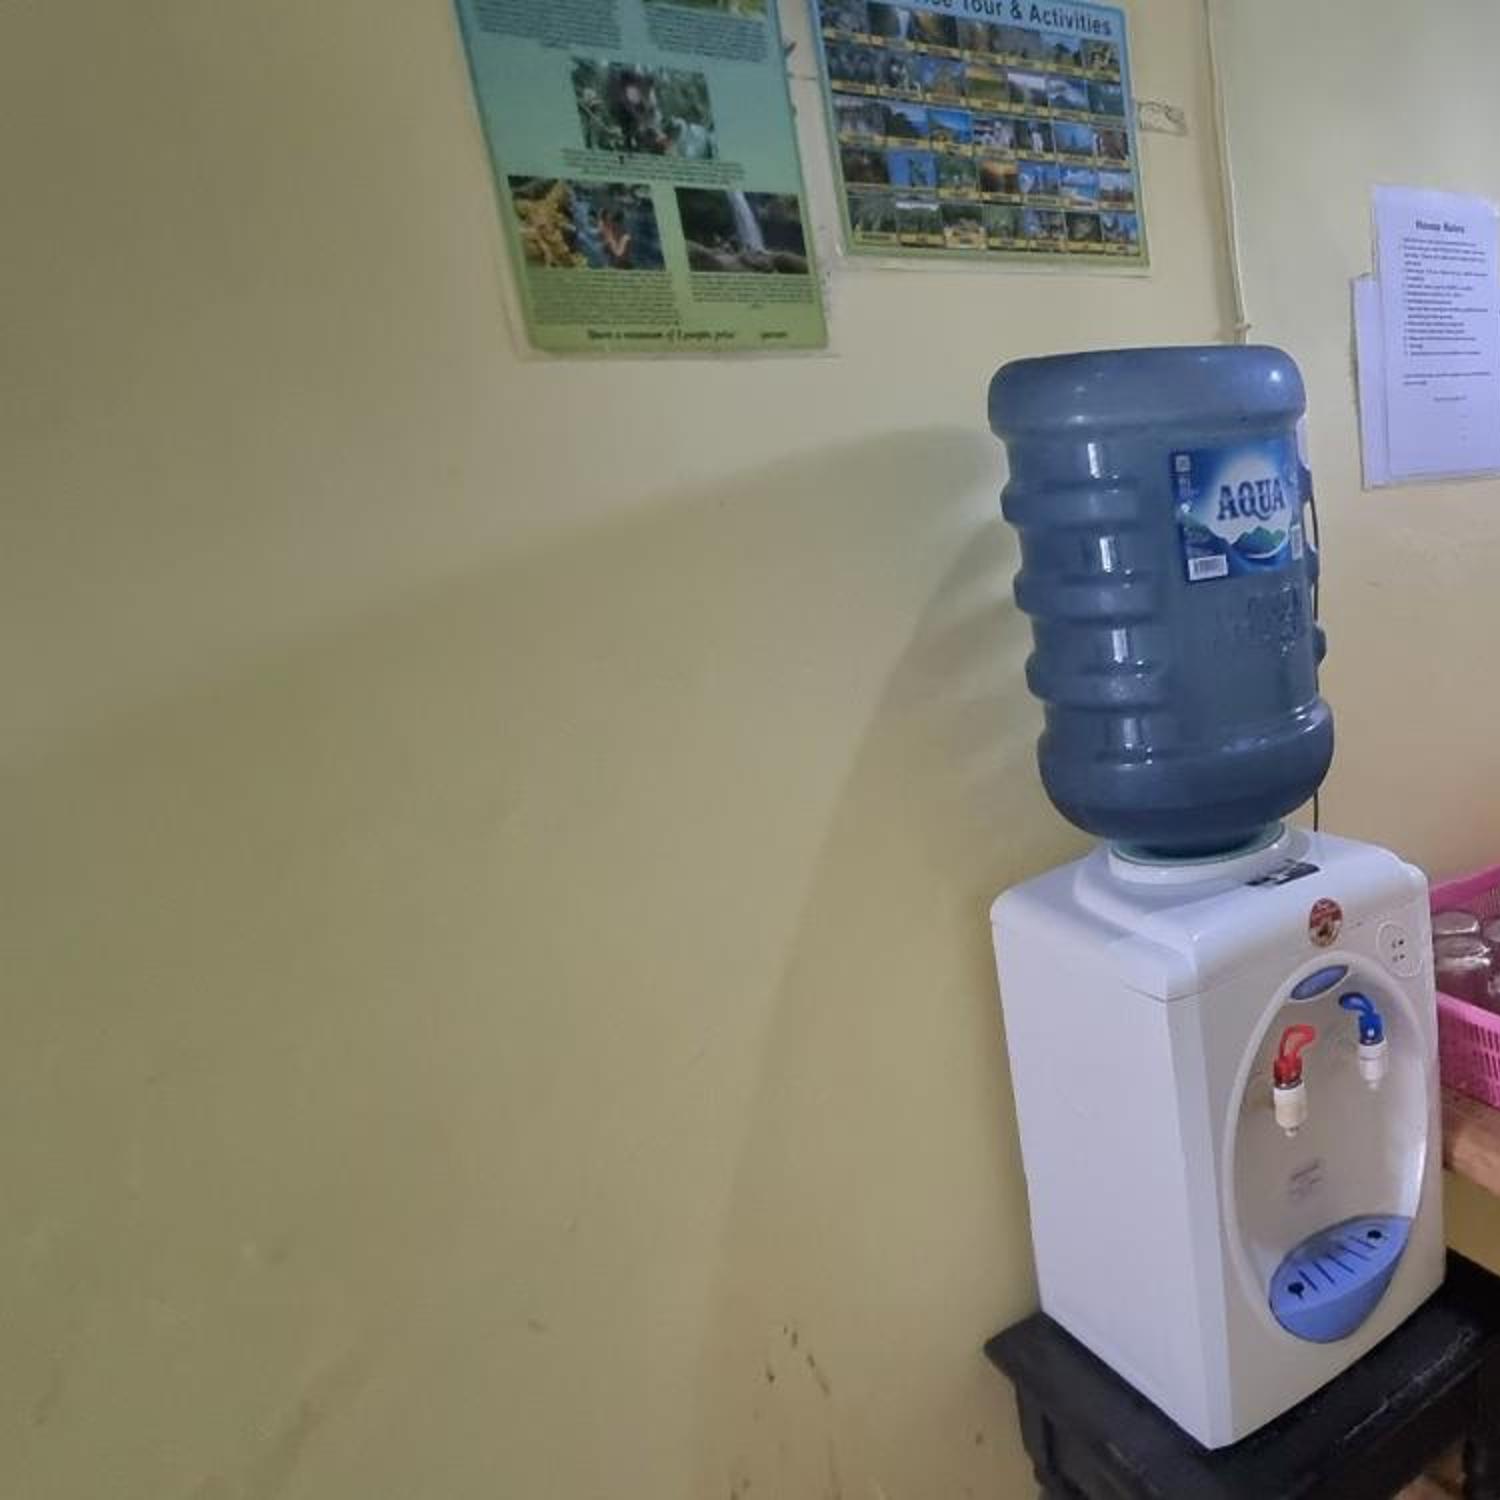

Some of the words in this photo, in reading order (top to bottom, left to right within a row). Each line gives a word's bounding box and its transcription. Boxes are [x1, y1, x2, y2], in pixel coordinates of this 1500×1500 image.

[1009, 6, 1023, 20] &
[1028, 5, 1112, 36] Activities
[1217, 479, 1287, 521] AQUA
